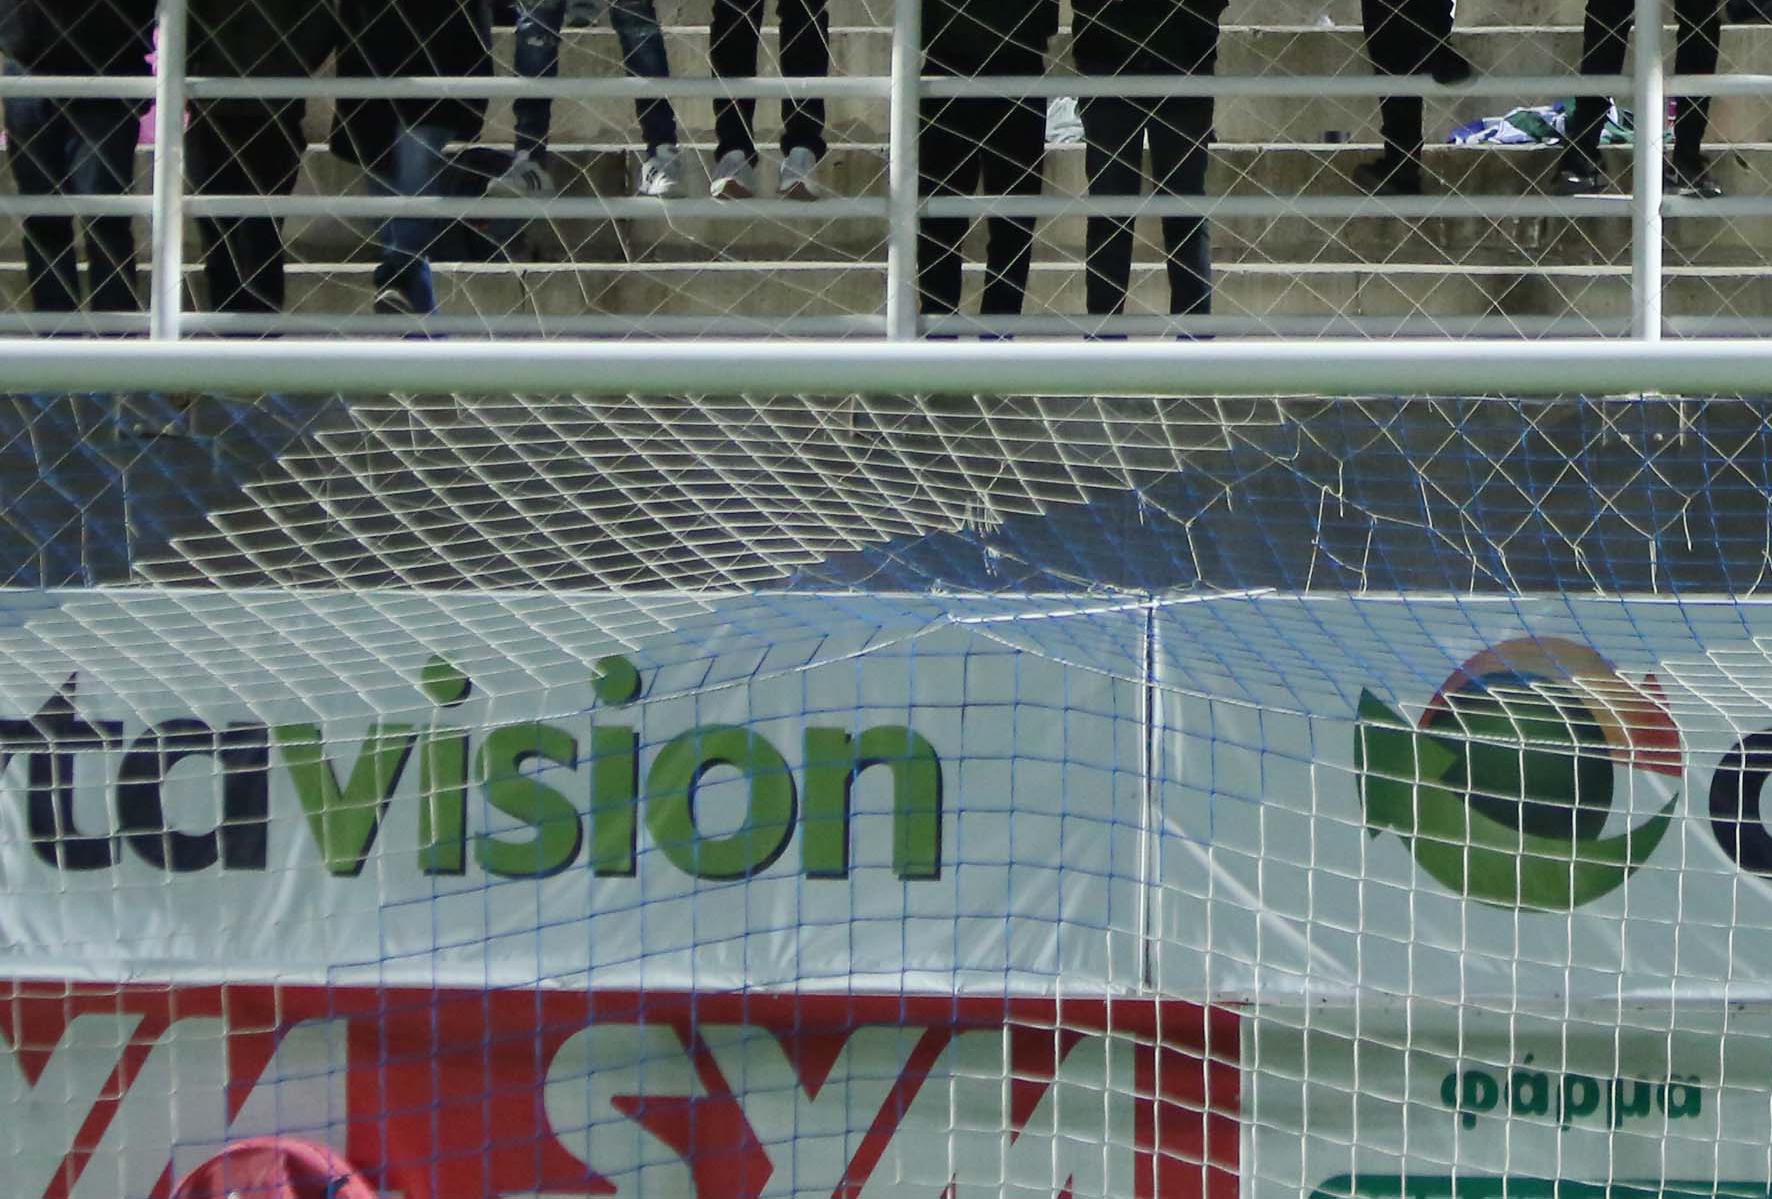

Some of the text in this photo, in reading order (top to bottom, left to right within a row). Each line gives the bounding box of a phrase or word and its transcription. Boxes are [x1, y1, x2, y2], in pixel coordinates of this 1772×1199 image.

[0, 654, 943, 882] tavision
[543, 1023, 1136, 1199] SYM
[1440, 1053, 1702, 1132] φάρμα
